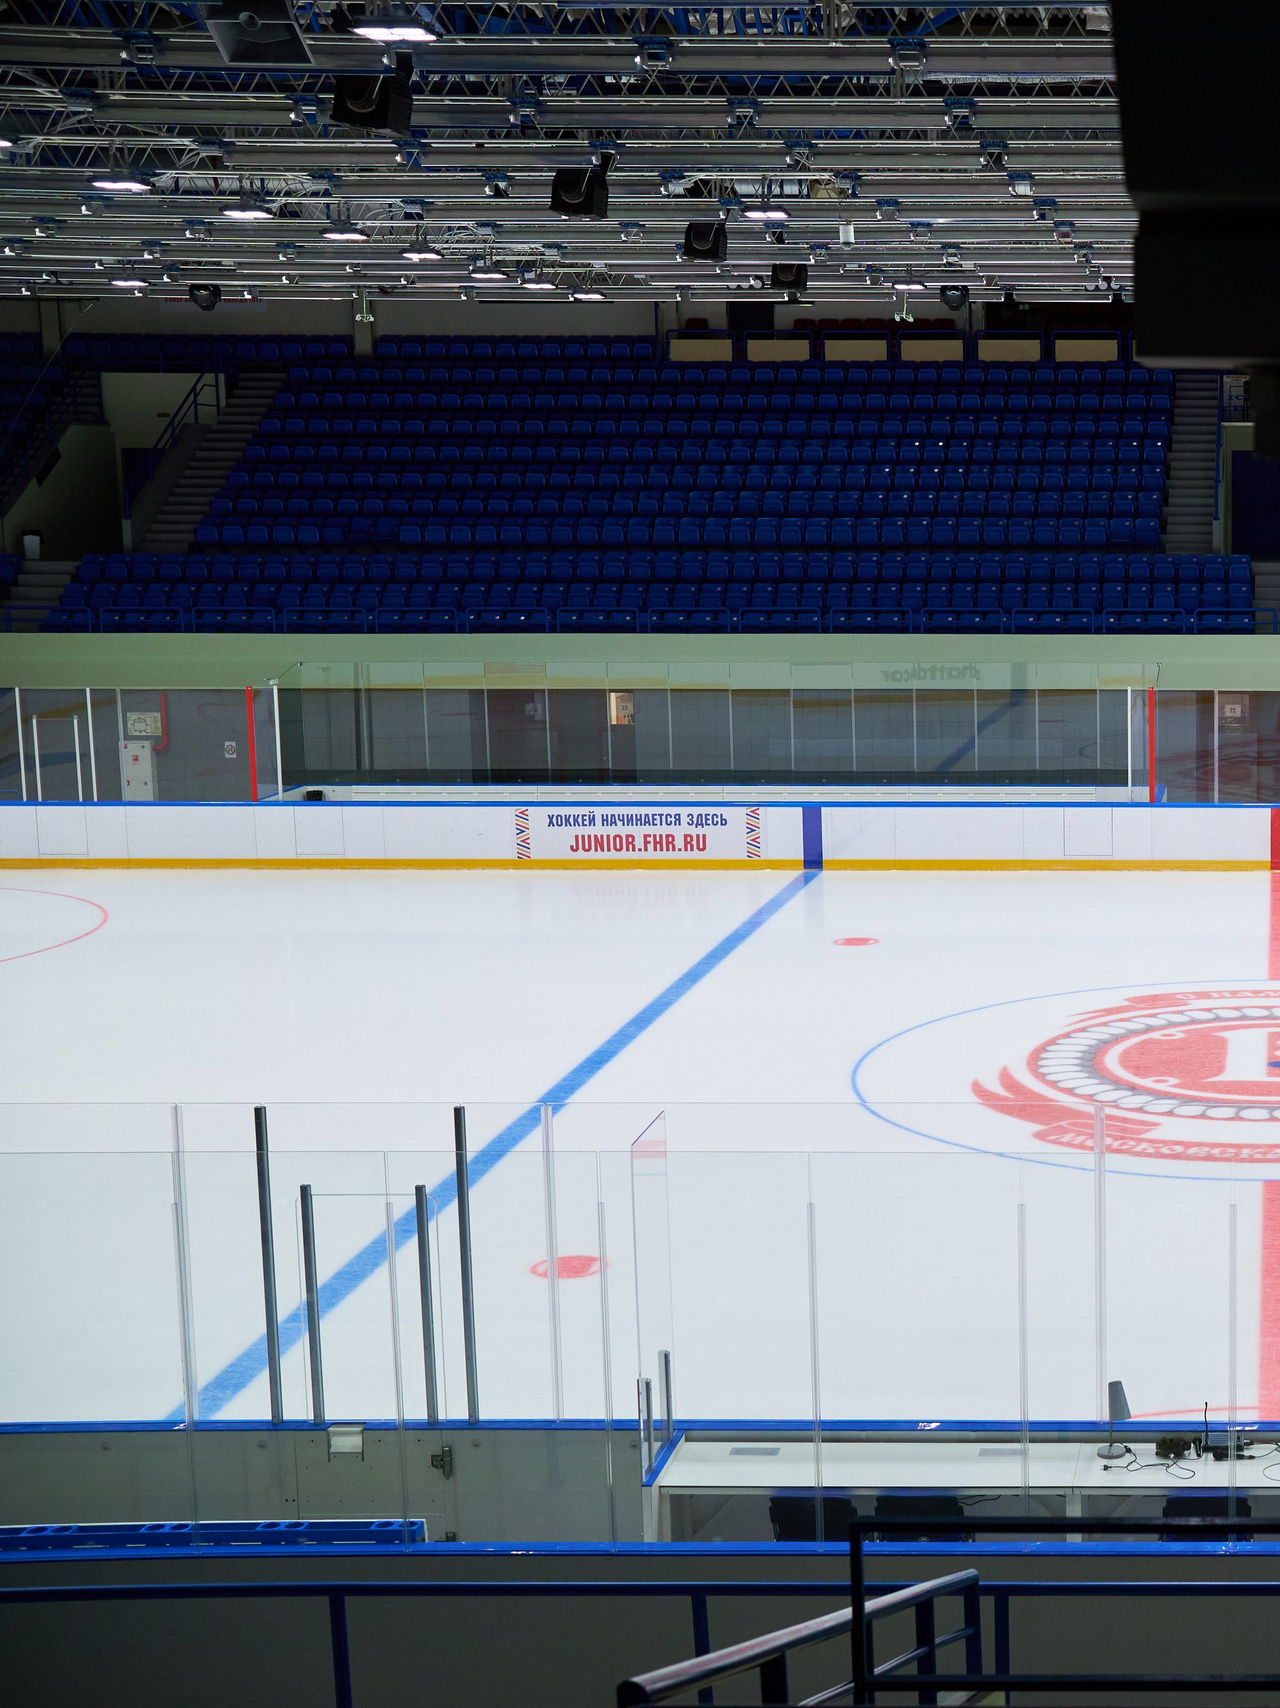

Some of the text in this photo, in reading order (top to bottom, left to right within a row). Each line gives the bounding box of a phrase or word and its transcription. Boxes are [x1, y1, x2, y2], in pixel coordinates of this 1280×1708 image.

[547, 810, 728, 828] ХОККЕЙ НАЧИНАЕТСЯ ЗДЕСЬ
[569, 833, 708, 853] JUNIOR.FHR.RU
